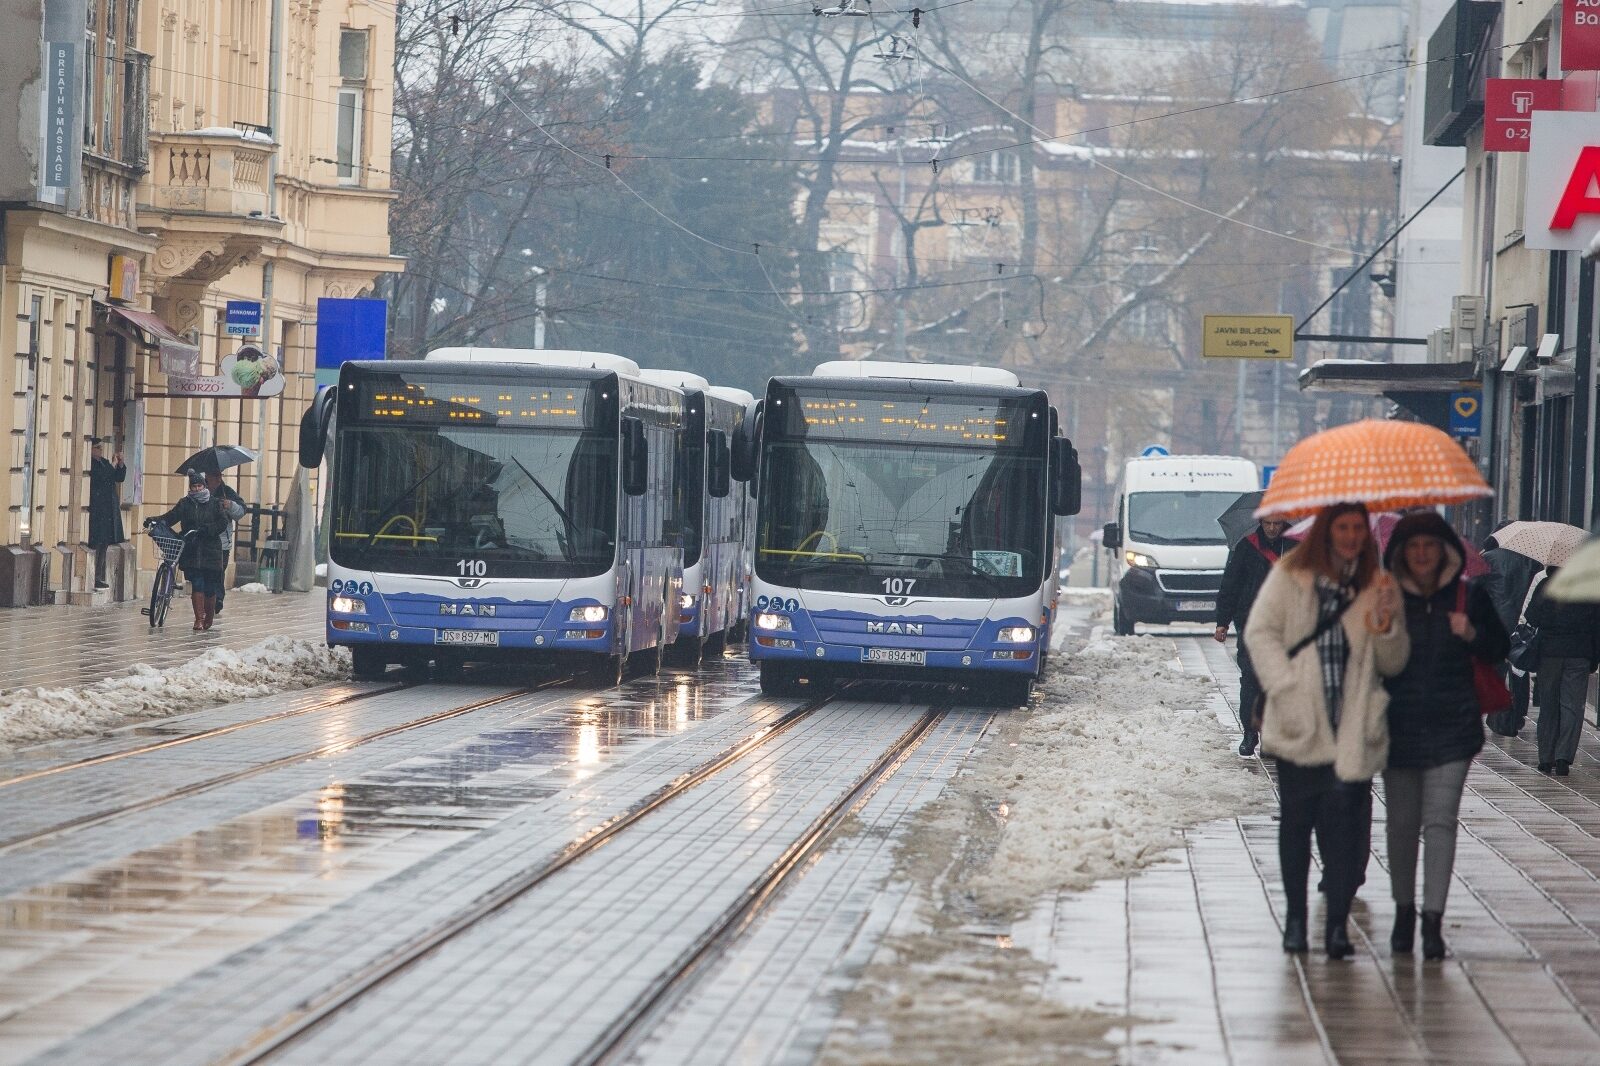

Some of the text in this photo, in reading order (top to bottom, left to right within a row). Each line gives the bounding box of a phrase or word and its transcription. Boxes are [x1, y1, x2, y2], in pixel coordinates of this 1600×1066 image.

[1505, 127, 1531, 139] 0-2
[228, 326, 250, 334] ERSTE
[180, 383, 220, 393] KORZO
[456, 559, 487, 577] 110
[881, 577, 917, 595] 107
[440, 603, 496, 617] MAN
[867, 621, 923, 636] MAN
